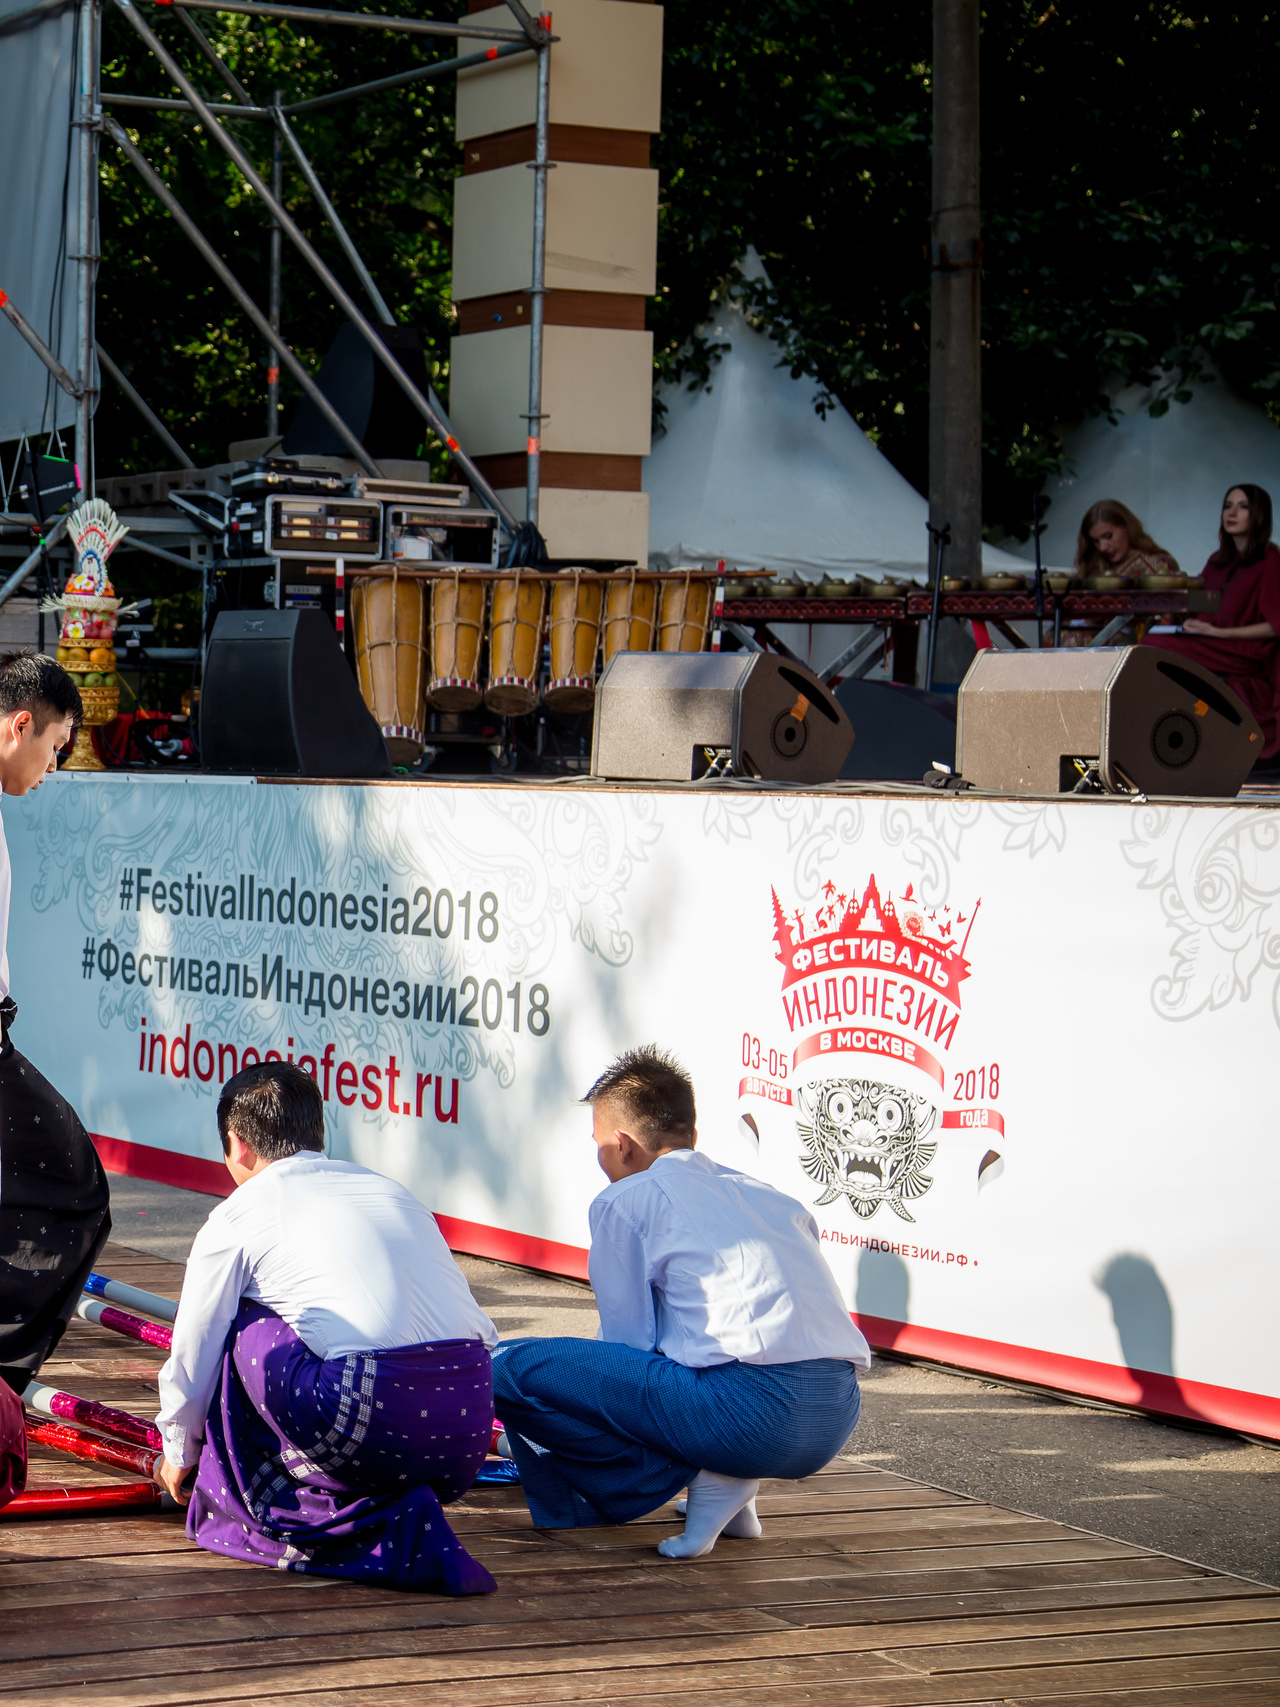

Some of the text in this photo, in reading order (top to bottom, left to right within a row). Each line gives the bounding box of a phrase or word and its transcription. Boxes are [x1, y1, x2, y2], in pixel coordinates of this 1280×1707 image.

[120, 868, 500, 943] #FestivalIndonesia2018
[792, 937, 950, 989] ФЕСТИВАЛЬ
[82, 937, 551, 1037] #ФестивальИндонезии2018
[781, 975, 961, 1051] ИНДОНЕЗИИ
[742, 1032, 788, 1079] 03-05
[819, 1030, 917, 1063] В МОСКВЕ
[139, 1017, 460, 1124] indoneafest.ru
[746, 1077, 788, 1103] августа
[953, 1063, 1000, 1101] 2018
[960, 1109, 989, 1128] года
[820, 1229, 968, 1267] АЛЬИНДОНЕЗИИ.РФ
